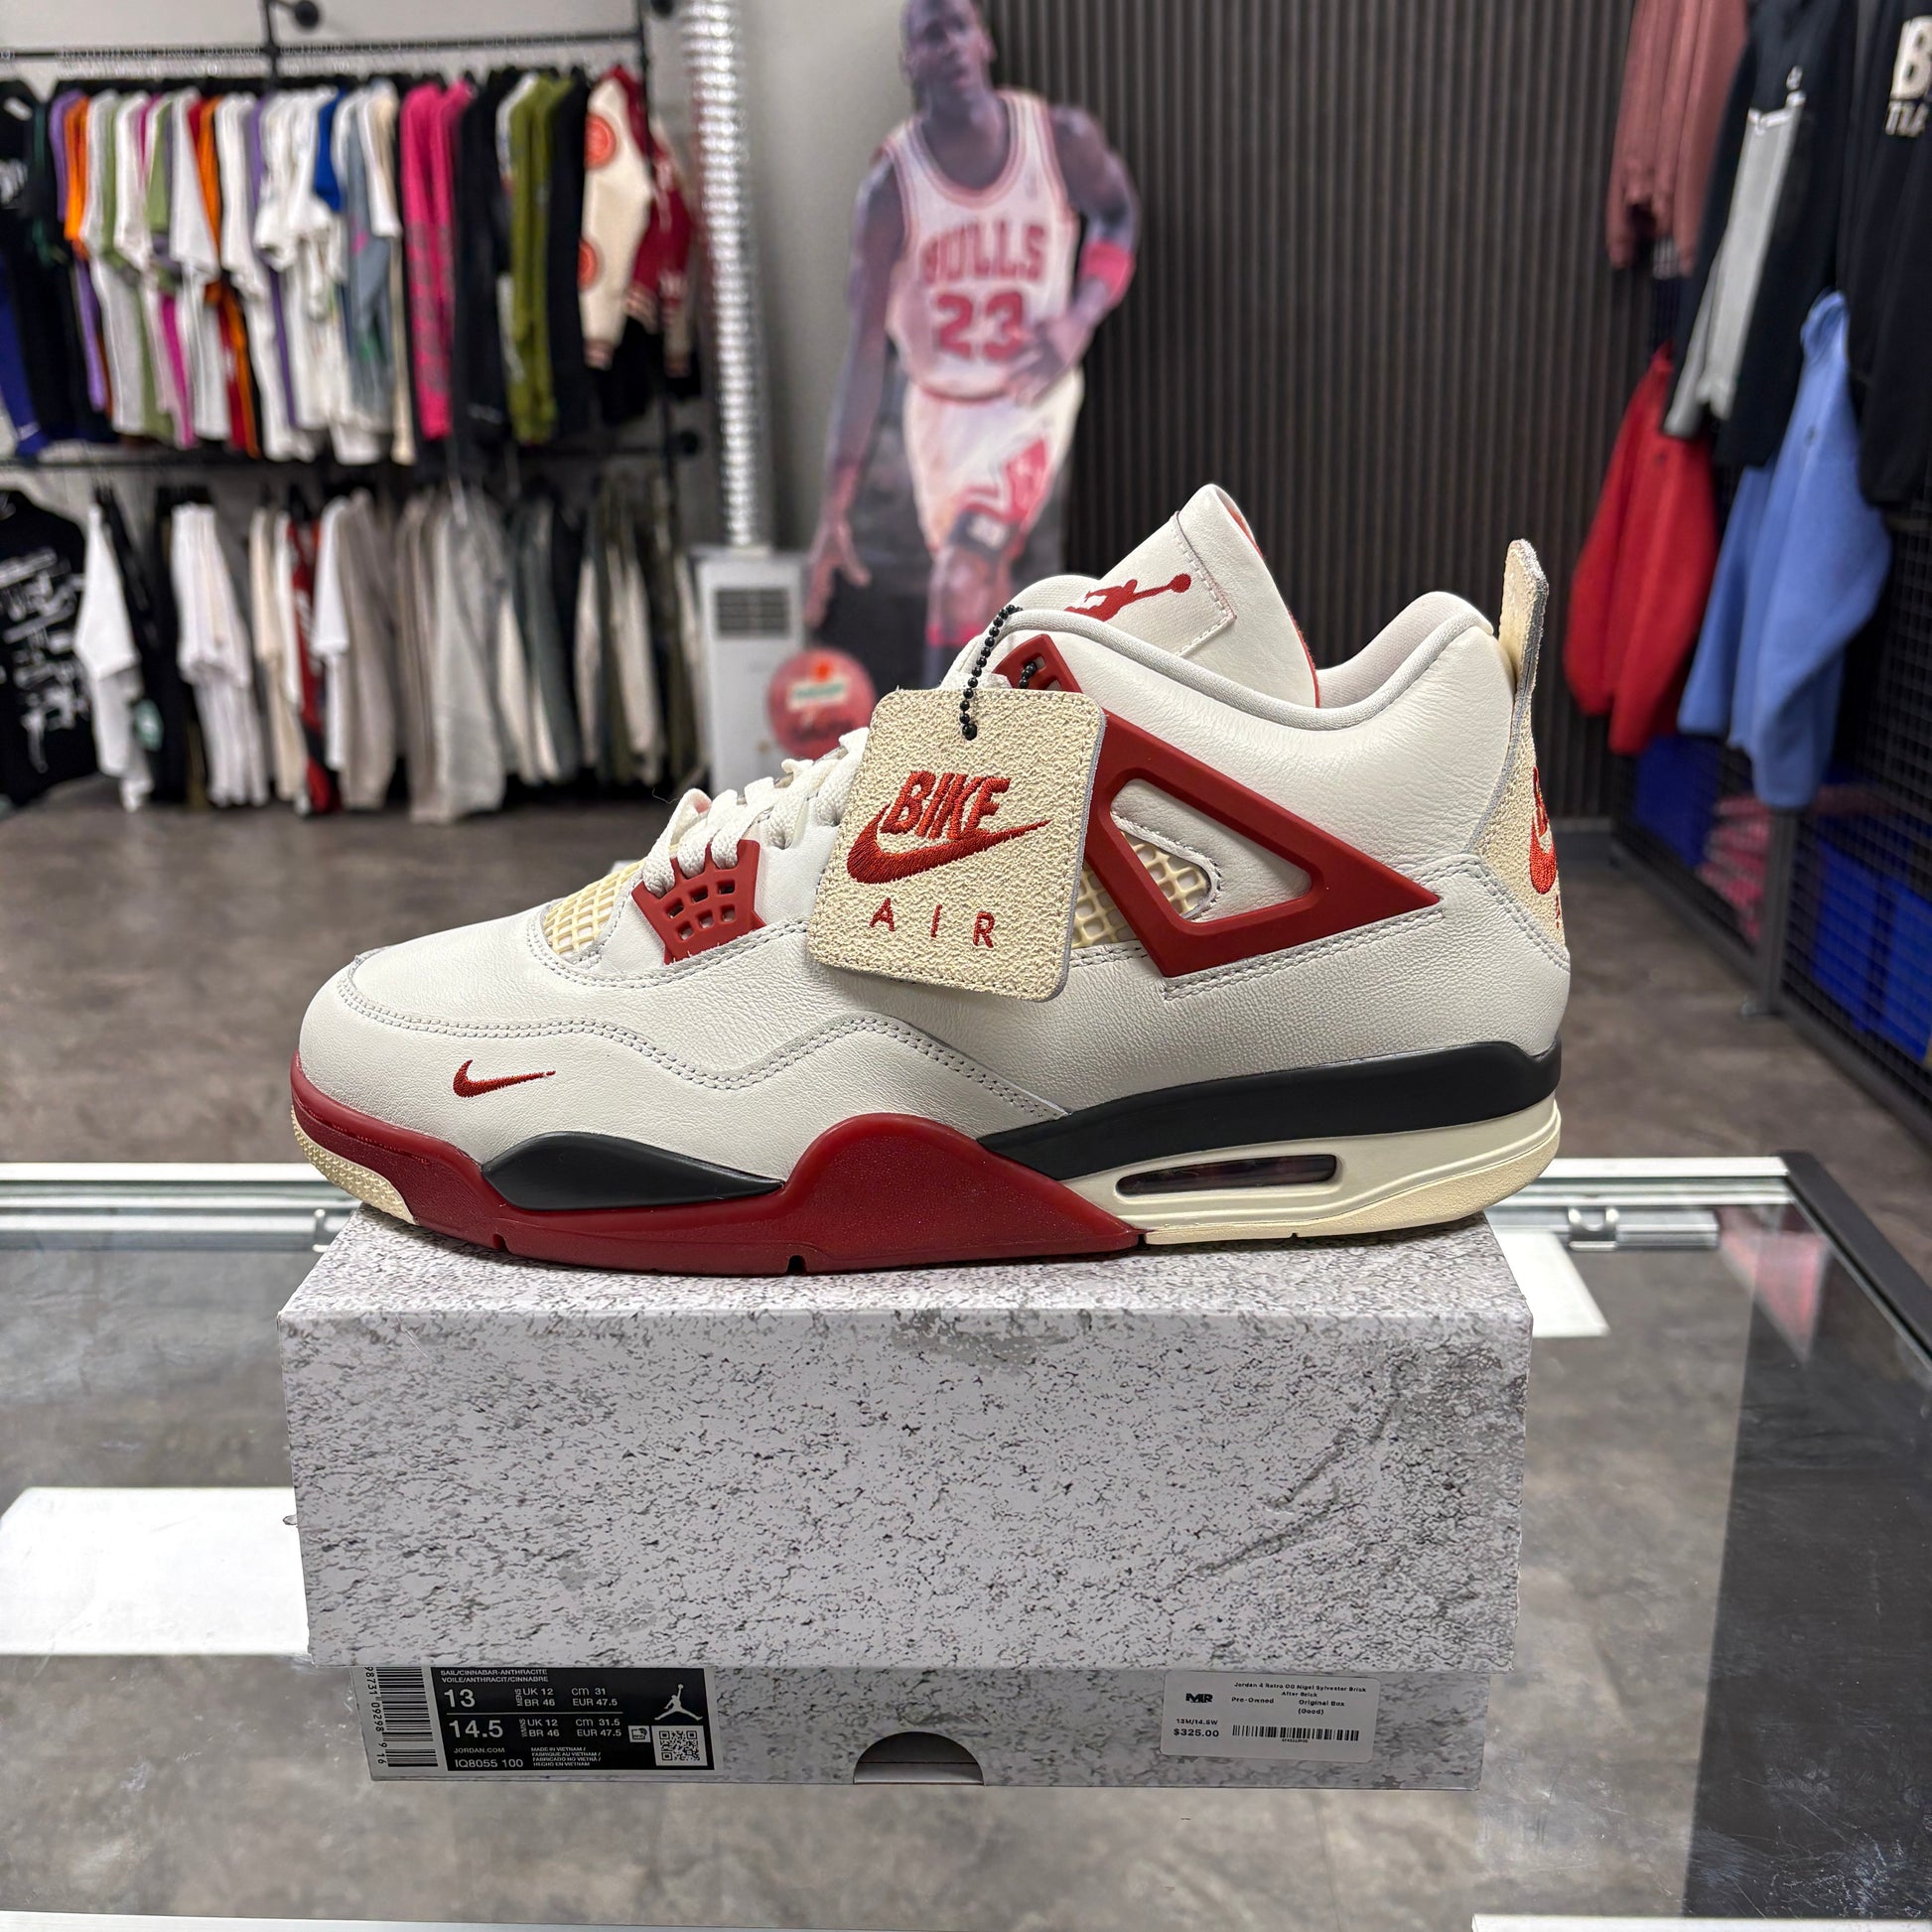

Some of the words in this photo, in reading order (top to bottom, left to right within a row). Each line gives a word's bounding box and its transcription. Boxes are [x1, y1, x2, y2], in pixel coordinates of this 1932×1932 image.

[936, 291, 1024, 362] 23
[880, 770, 1011, 841] BIKE
[869, 897, 996, 948] AIR
[444, 1689, 476, 1708] 13
[370, 1702, 384, 1732] 09298
[449, 1720, 503, 1738] 14.5
[1173, 1727, 1219, 1737] $325.00
[455, 1759, 498, 1768] IQ8055
[501, 1759, 523, 1768] 100
